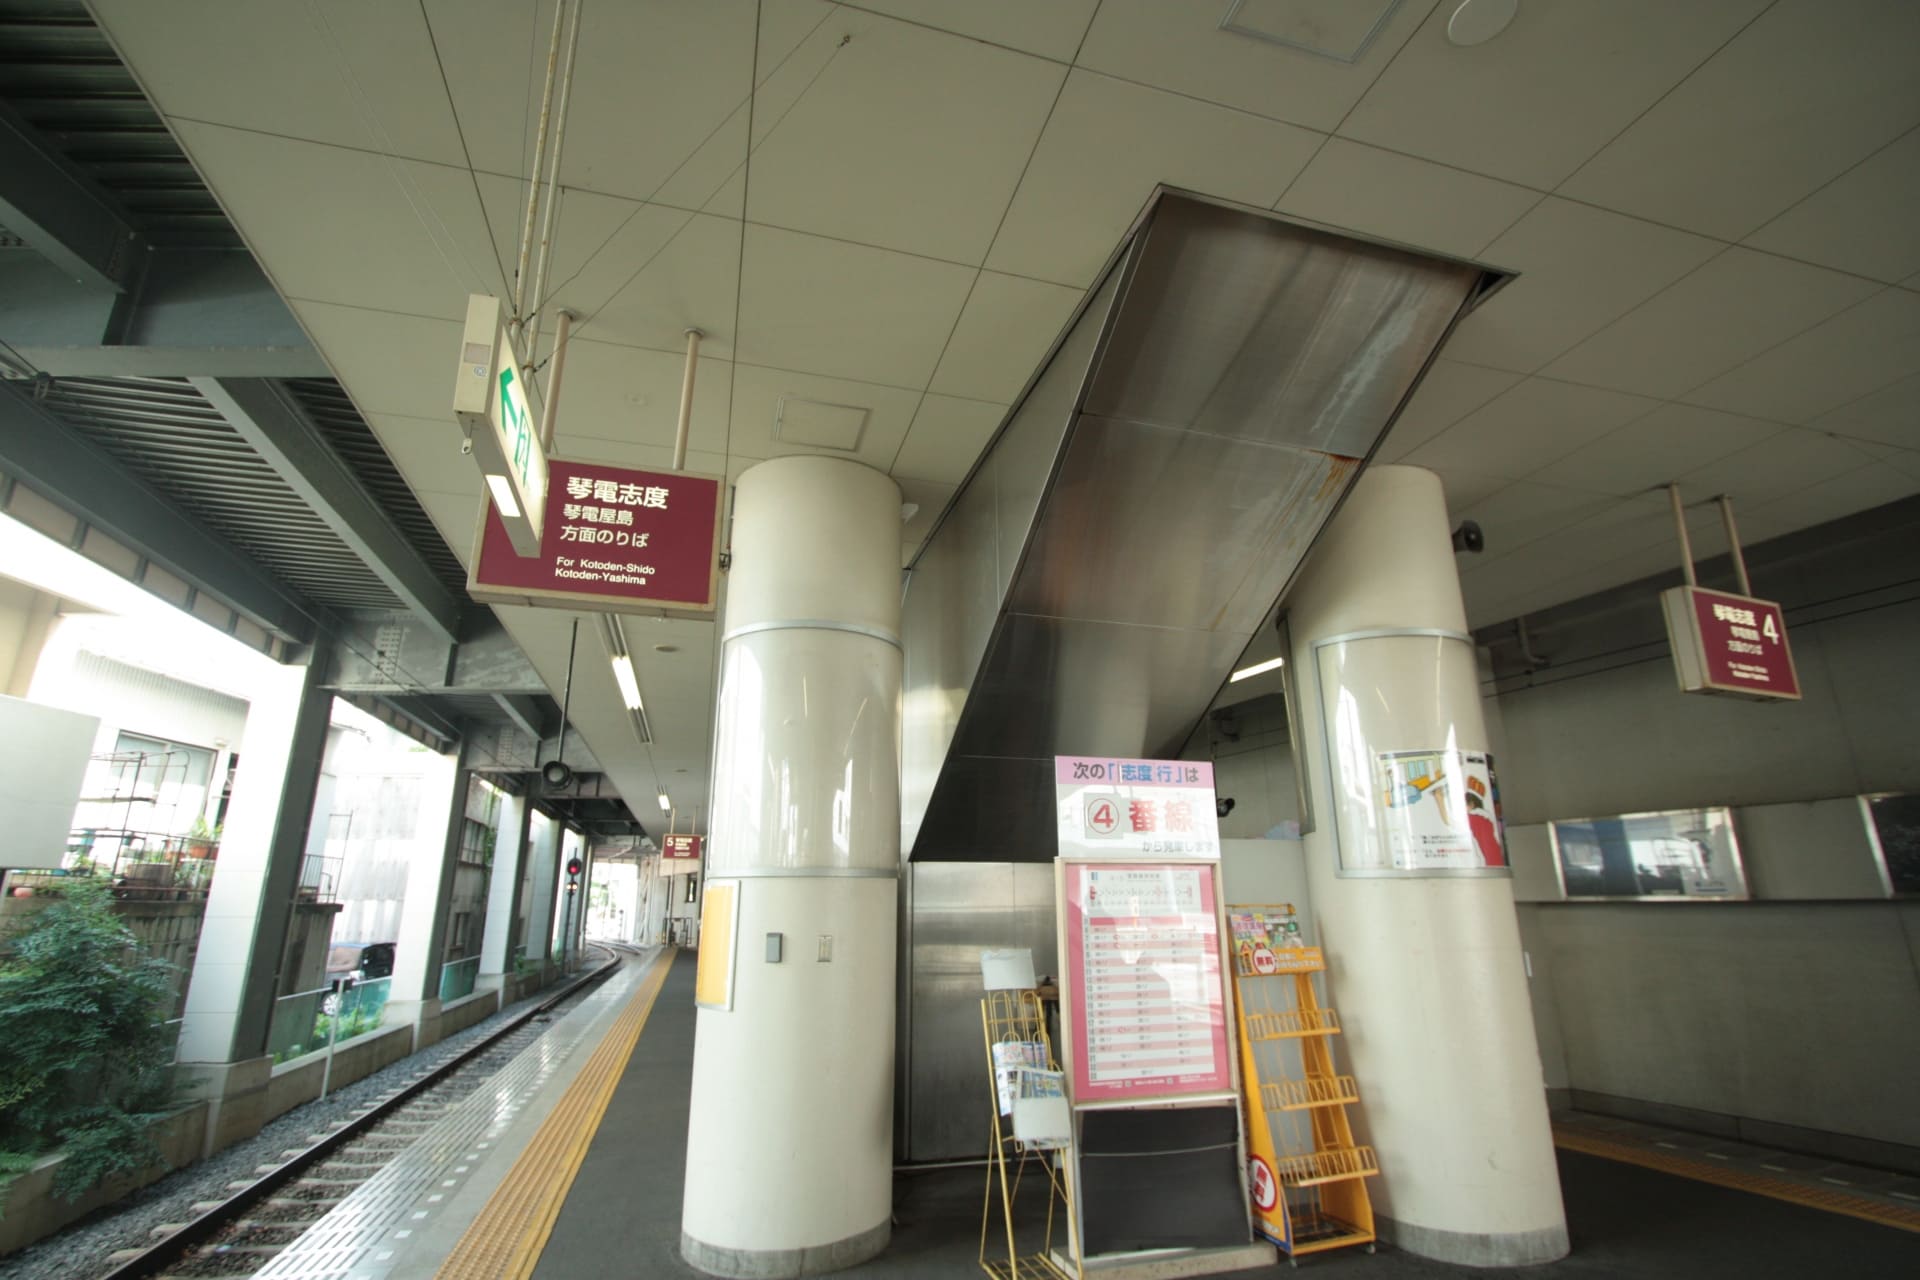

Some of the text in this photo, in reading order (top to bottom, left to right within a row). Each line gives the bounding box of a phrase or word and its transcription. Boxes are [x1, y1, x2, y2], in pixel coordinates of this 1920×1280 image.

[566, 476, 669, 510] 琴電志度
[563, 503, 634, 526] 琴電屋島
[560, 525, 650, 548] 方面のりば
[555, 567, 646, 585] Kotoden-Yashima
[556, 556, 656, 575] For Kotoden-Shido
[1763, 613, 1779, 645] 4
